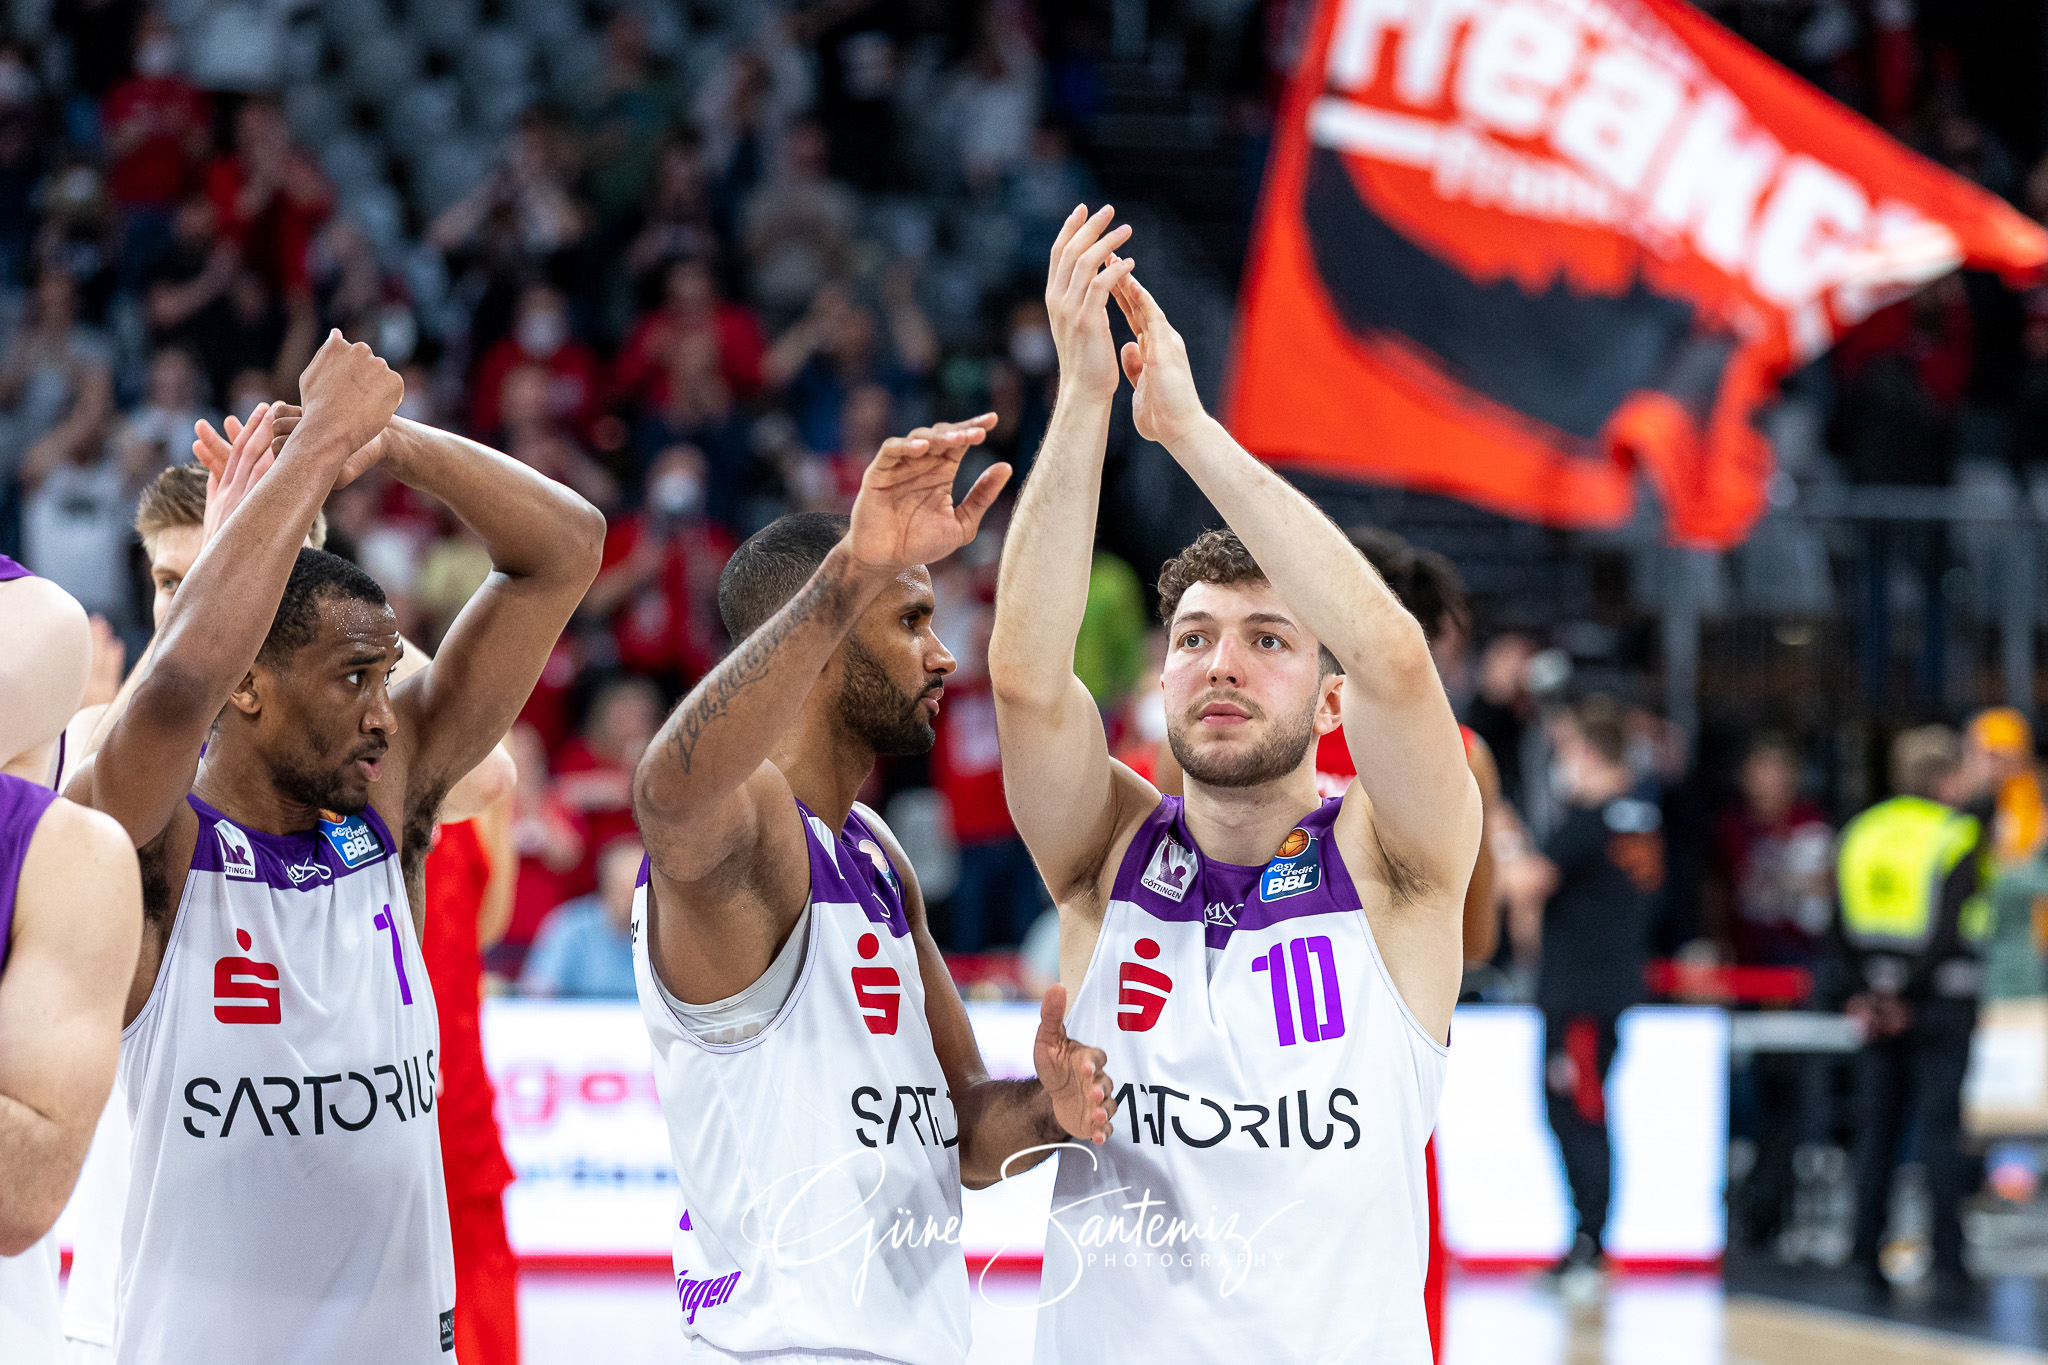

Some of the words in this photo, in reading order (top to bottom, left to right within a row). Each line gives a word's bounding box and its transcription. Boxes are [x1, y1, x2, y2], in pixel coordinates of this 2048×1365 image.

[342, 834, 378, 861] BBL
[1143, 877, 1182, 900] GÖTTINGEN
[1266, 874, 1313, 896] BBL
[1251, 934, 1345, 1047] 10
[1113, 1082, 1361, 1151] ATORIUS
